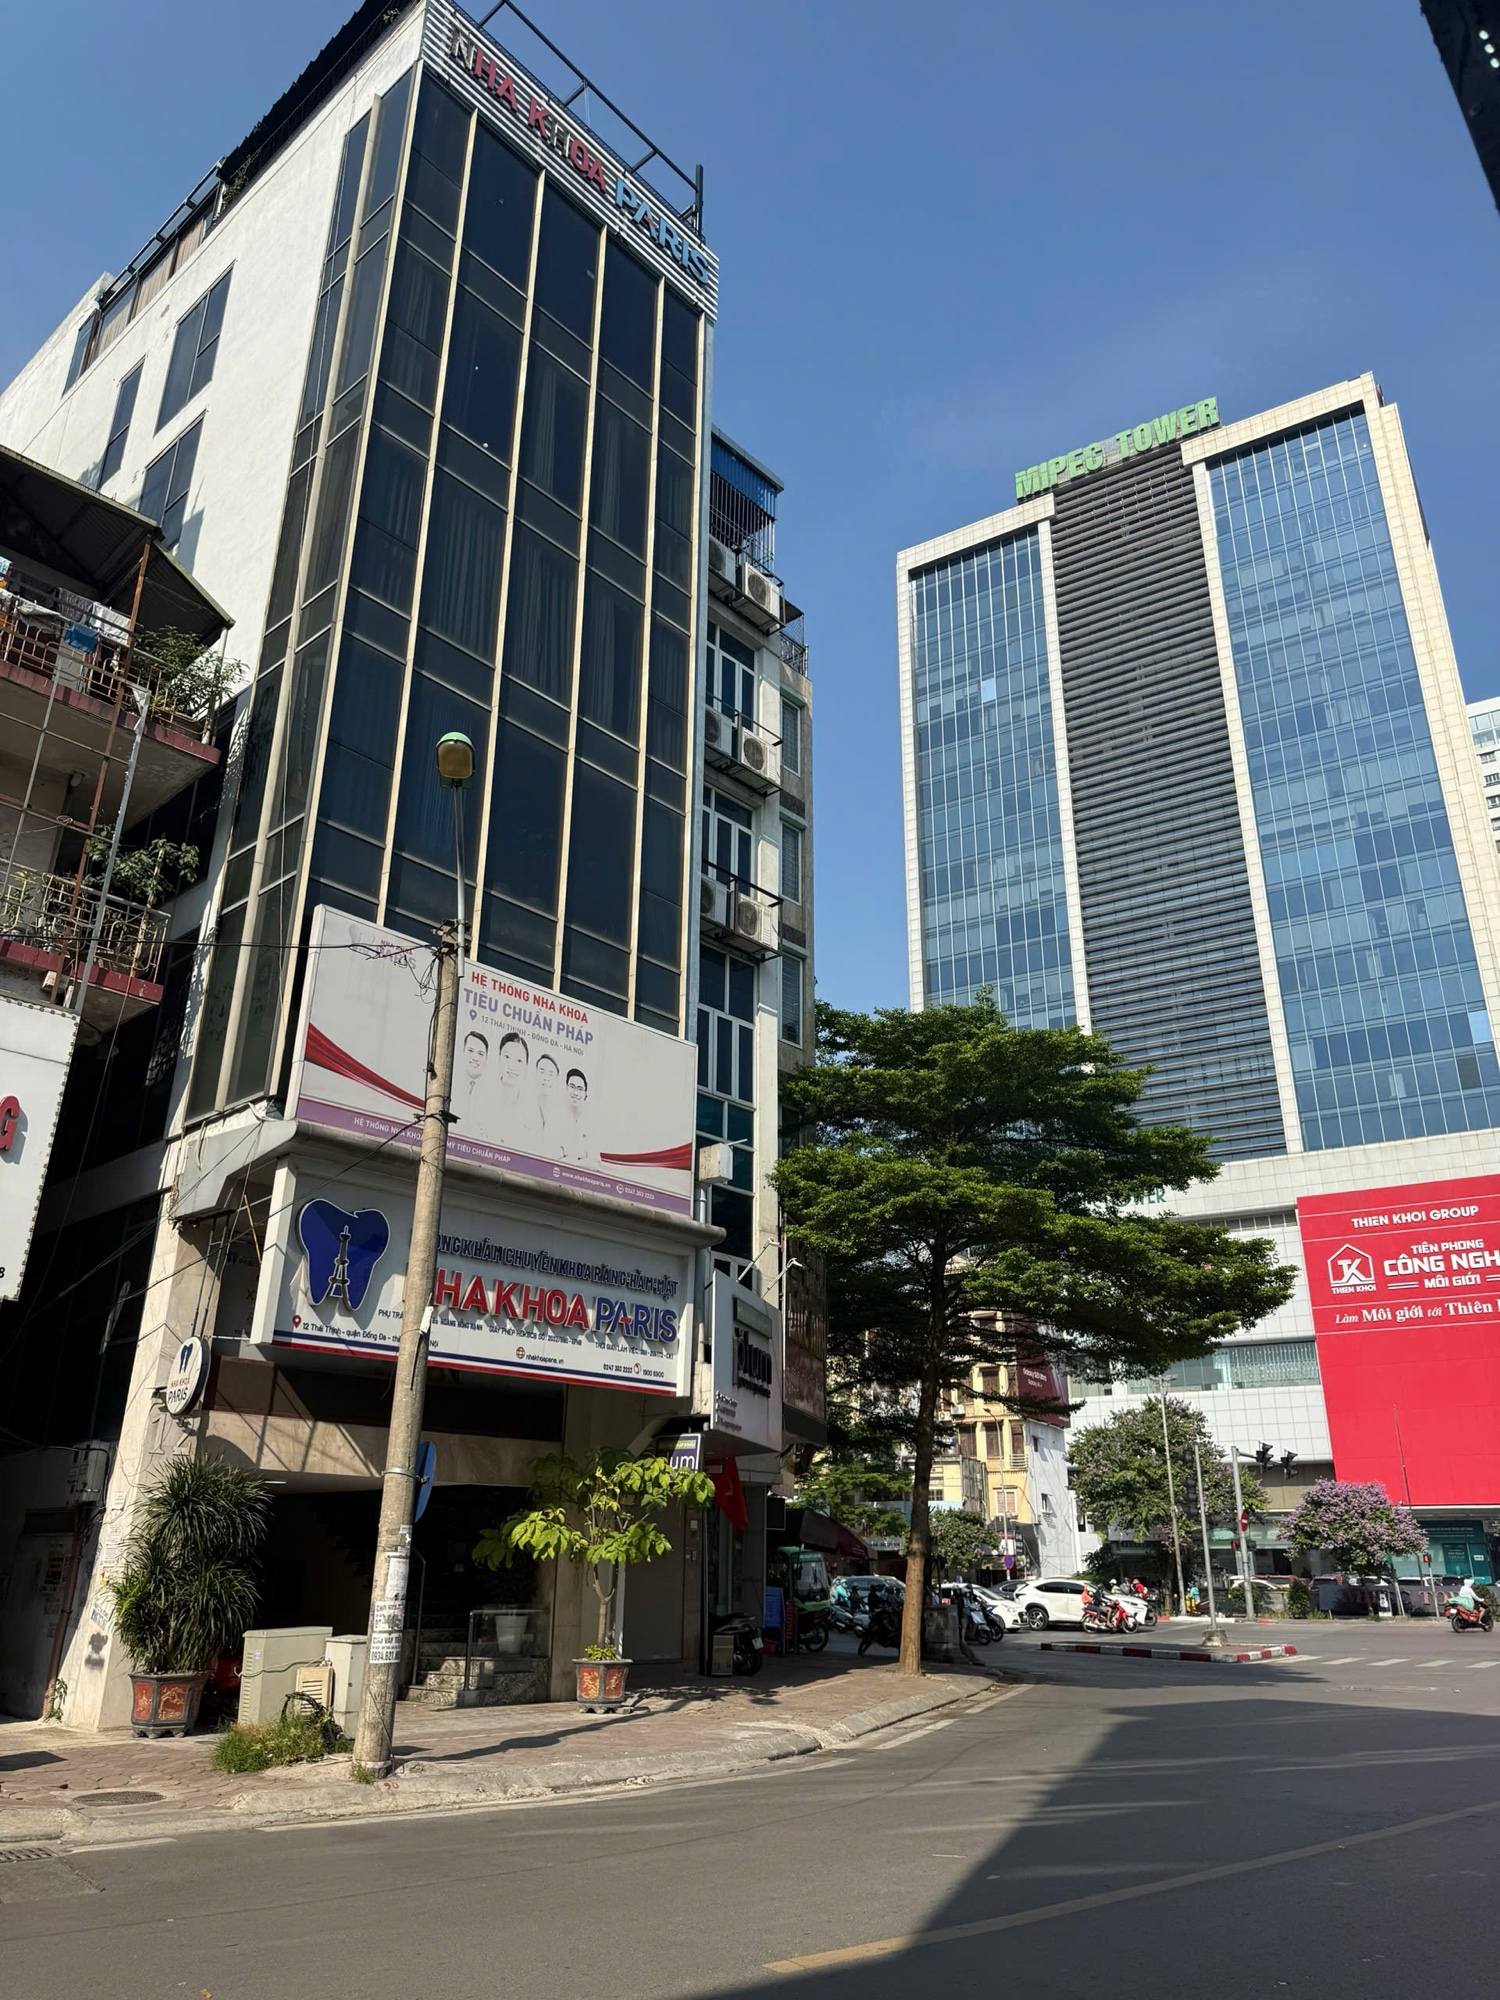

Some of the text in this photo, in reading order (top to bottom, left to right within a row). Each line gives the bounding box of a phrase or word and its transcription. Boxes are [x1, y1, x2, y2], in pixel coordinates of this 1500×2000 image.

[614, 177, 710, 286] PARIS
[1015, 396, 1221, 499] MIPEC TOWER
[471, 971, 588, 1024] HỆ THỐNG NHA KHOA
[464, 988, 594, 1045] TIÊU CHUẨN PHÁP
[481, 1015, 489, 1026] 12
[353, 1116, 365, 1127] HỆ
[366, 1120, 390, 1132] THỐNG
[391, 1126, 406, 1136] NHA
[456, 1143, 471, 1154] TIÊU
[494, 1152, 511, 1164] PHÁP
[1352, 1205, 1479, 1229] THIEN KHOI GROUP
[1411, 1239, 1484, 1254] TIÊN PHONG
[559, 1258, 591, 1281] KHOA
[1383, 1253, 1446, 1276] CÔNG
[1424, 1271, 1481, 1289] MÔI GIỚI
[434, 1267, 490, 1315] HA
[592, 1297, 678, 1344] PARIS
[1335, 1313, 1359, 1324] Làm
[1361, 1306, 1393, 1322] Môi
[1395, 1305, 1424, 1323] giới
[1427, 1306, 1443, 1318] tới
[1445, 1300, 1494, 1316] Thiên
[303, 1322, 310, 1330] 12
[311, 1323, 324, 1332] Thái
[168, 1387, 189, 1405] PARIS
